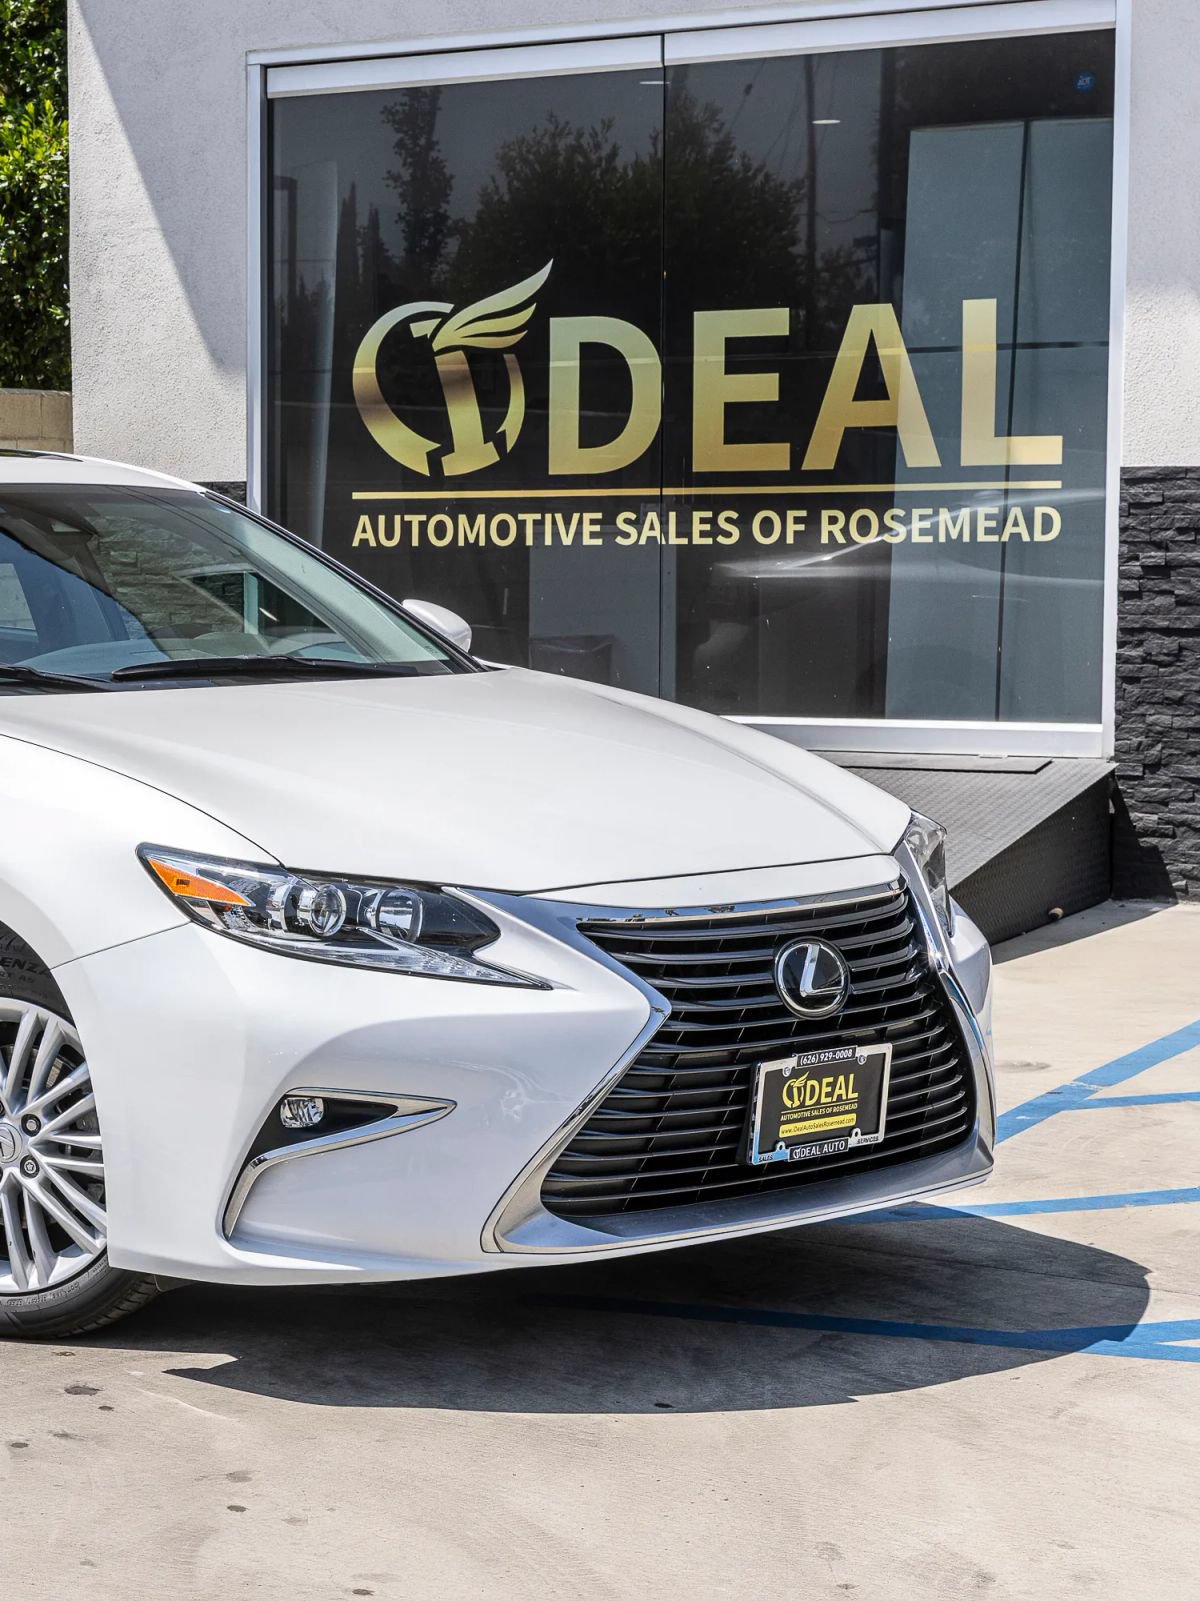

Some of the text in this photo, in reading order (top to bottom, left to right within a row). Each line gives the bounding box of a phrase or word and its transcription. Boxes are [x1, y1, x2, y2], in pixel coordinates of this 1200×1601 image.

[352, 505, 1063, 548] AUTOMOTIVE SALES OF ROSEMEAD
[800, 1048, 853, 1066] (626) 929-0008
[780, 1111, 811, 1121] AUTOMOTIVE
[811, 1108, 826, 1117] SALES
[832, 1103, 858, 1113] ROSEMEAD
[822, 1140, 846, 1154] AUTO
